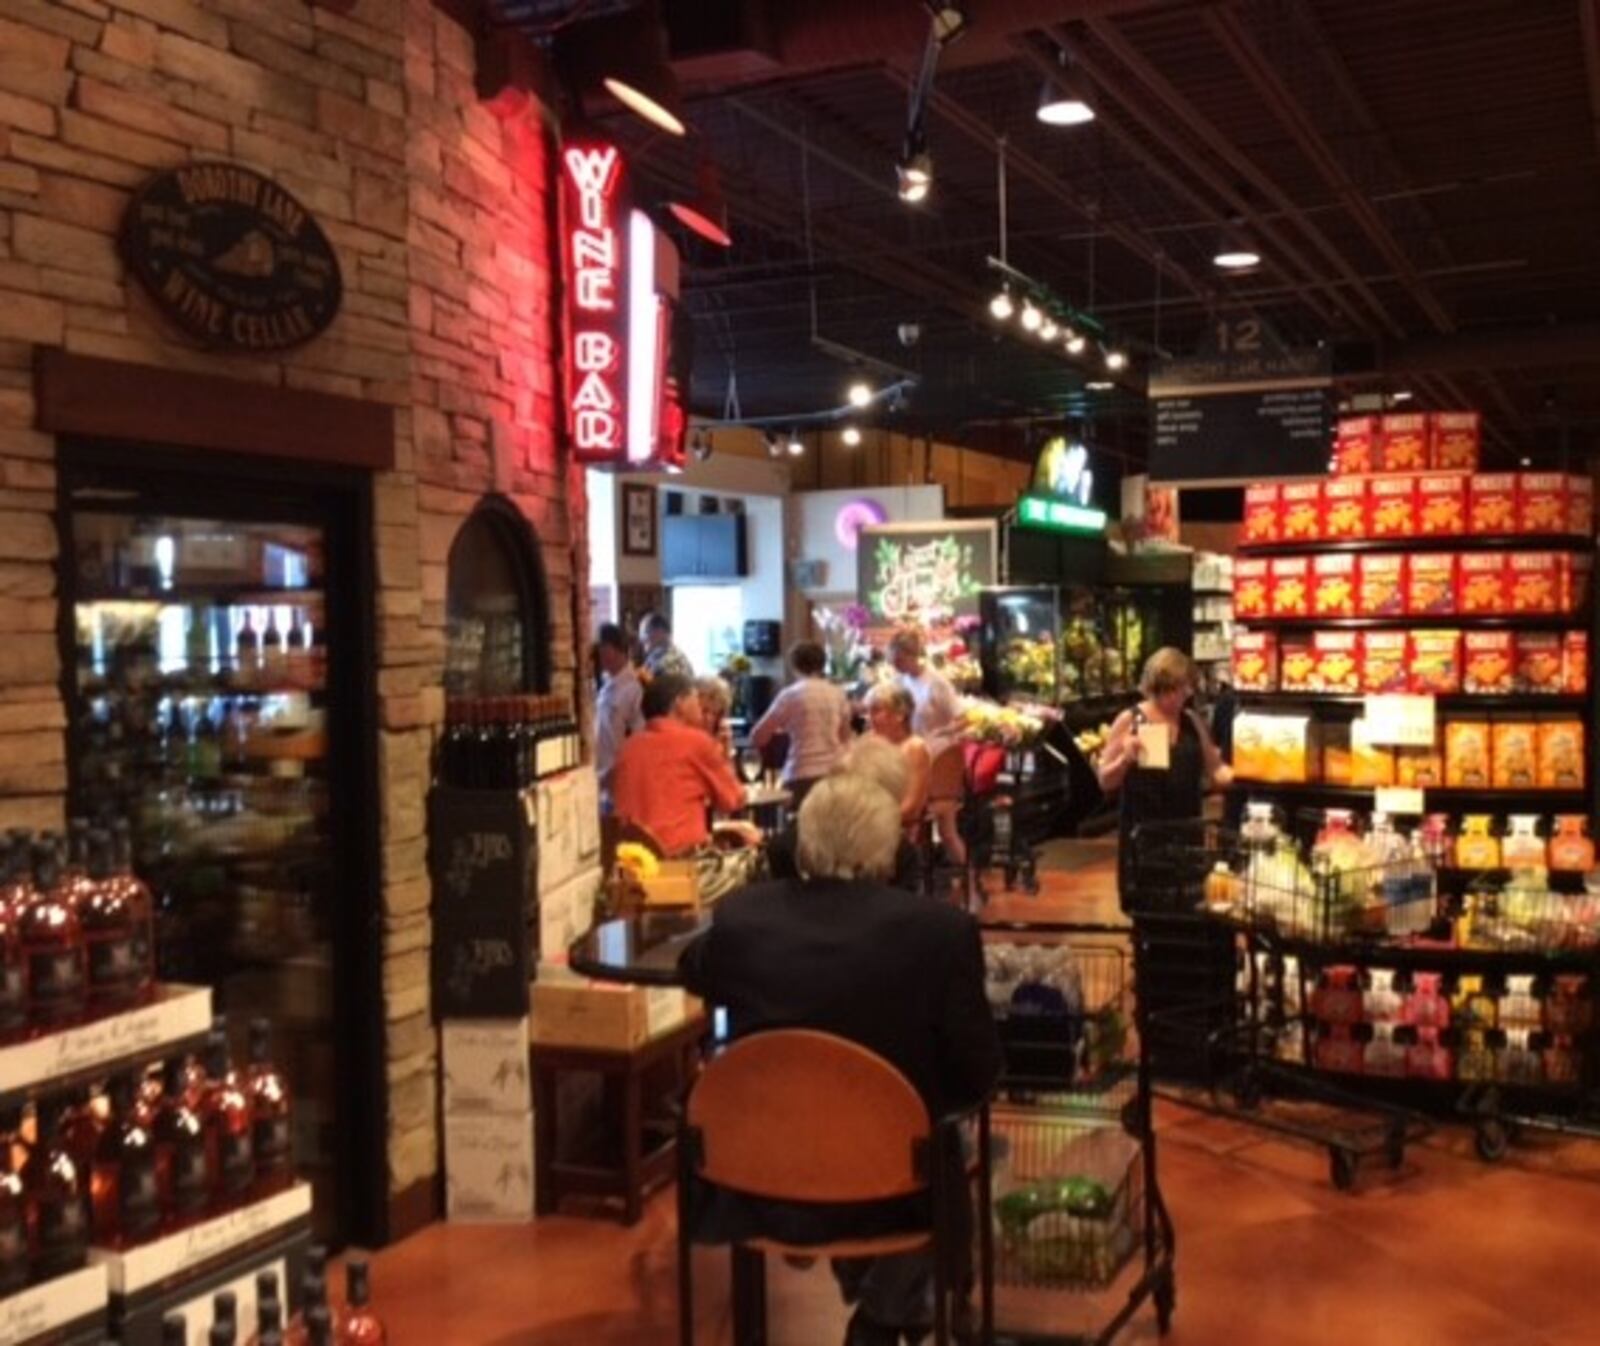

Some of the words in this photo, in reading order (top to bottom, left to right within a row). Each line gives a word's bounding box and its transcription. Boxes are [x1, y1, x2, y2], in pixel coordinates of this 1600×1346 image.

[565, 147, 617, 310] WINE
[572, 331, 617, 450] BAR
[1217, 319, 1262, 351] 12
